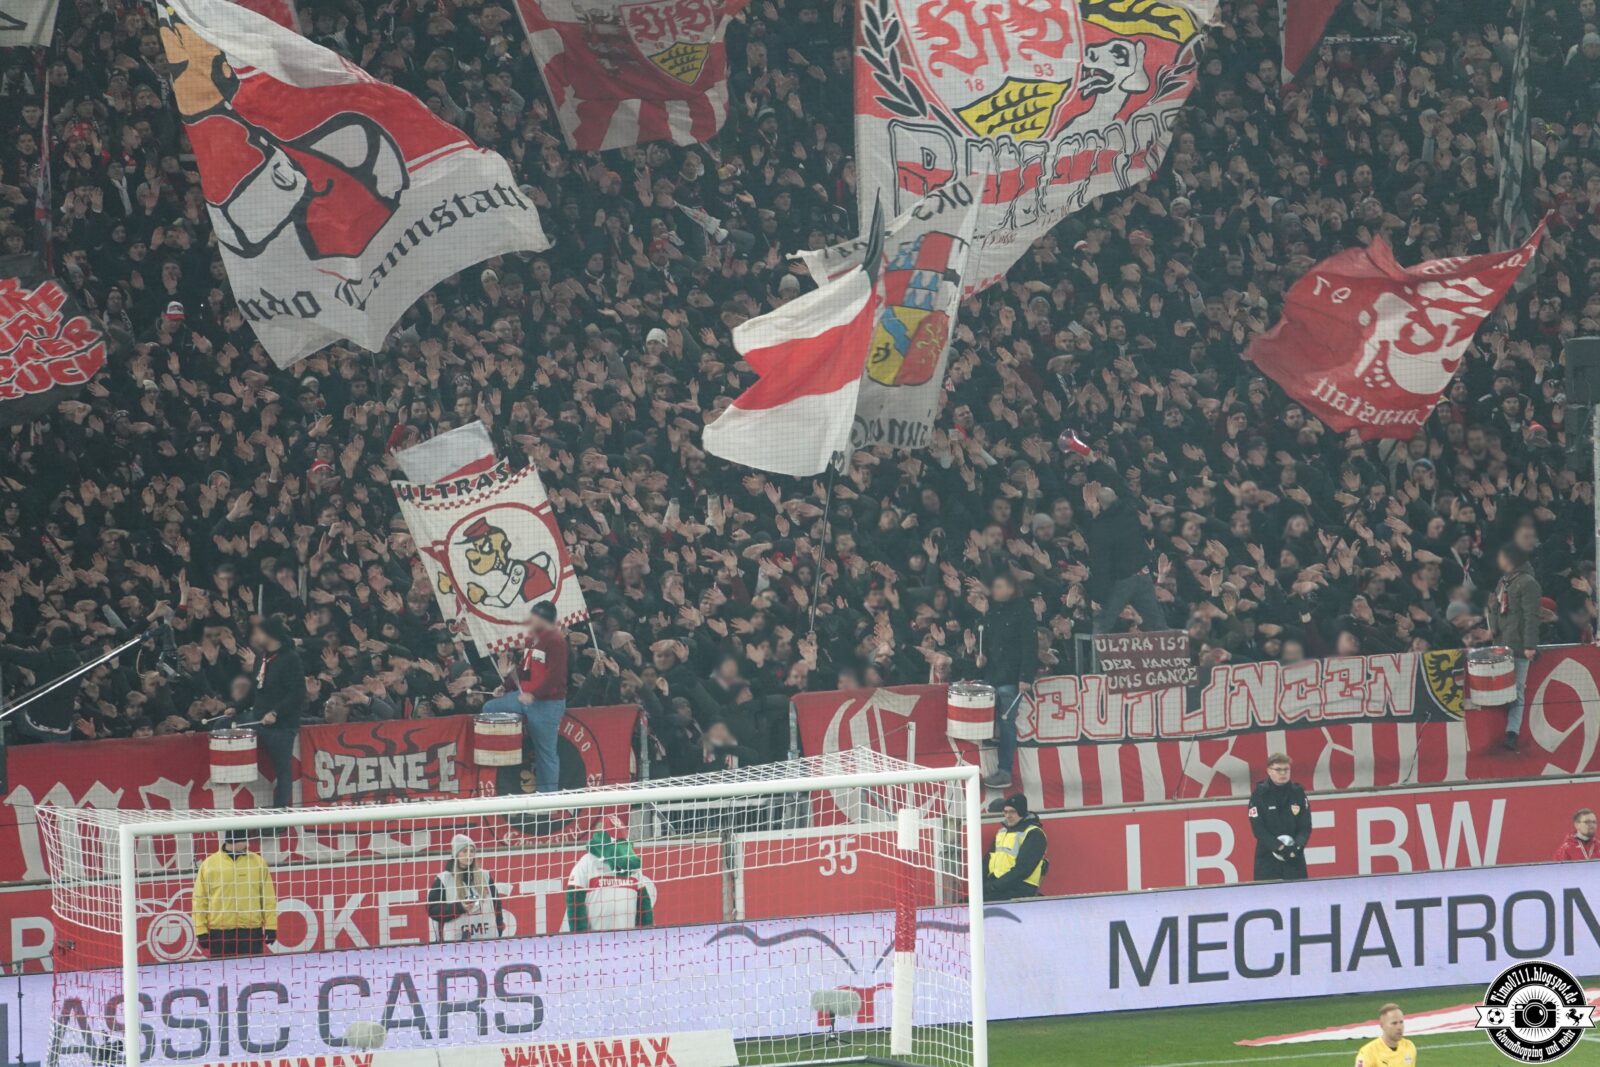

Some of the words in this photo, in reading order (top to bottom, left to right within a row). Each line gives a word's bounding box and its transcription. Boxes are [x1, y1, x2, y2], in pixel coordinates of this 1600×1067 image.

[963, 78, 985, 93] 18
[1033, 63, 1055, 78] 93
[397, 462, 510, 501] ULTRAS
[1095, 637, 1153, 652] ULTRA
[1159, 635, 1189, 651] IST
[1101, 659, 1136, 672] DER
[1141, 657, 1191, 669] KAMPF
[1108, 673, 1142, 690] UMS
[1145, 667, 1198, 686] GANZE
[315, 750, 430, 800] SZENE
[438, 743, 460, 794] E
[819, 838, 857, 876] 35
[1108, 887, 1600, 990] MECHATRON
[318, 963, 544, 1048] CARS
[501, 1037, 677, 1067] WINAMAX
